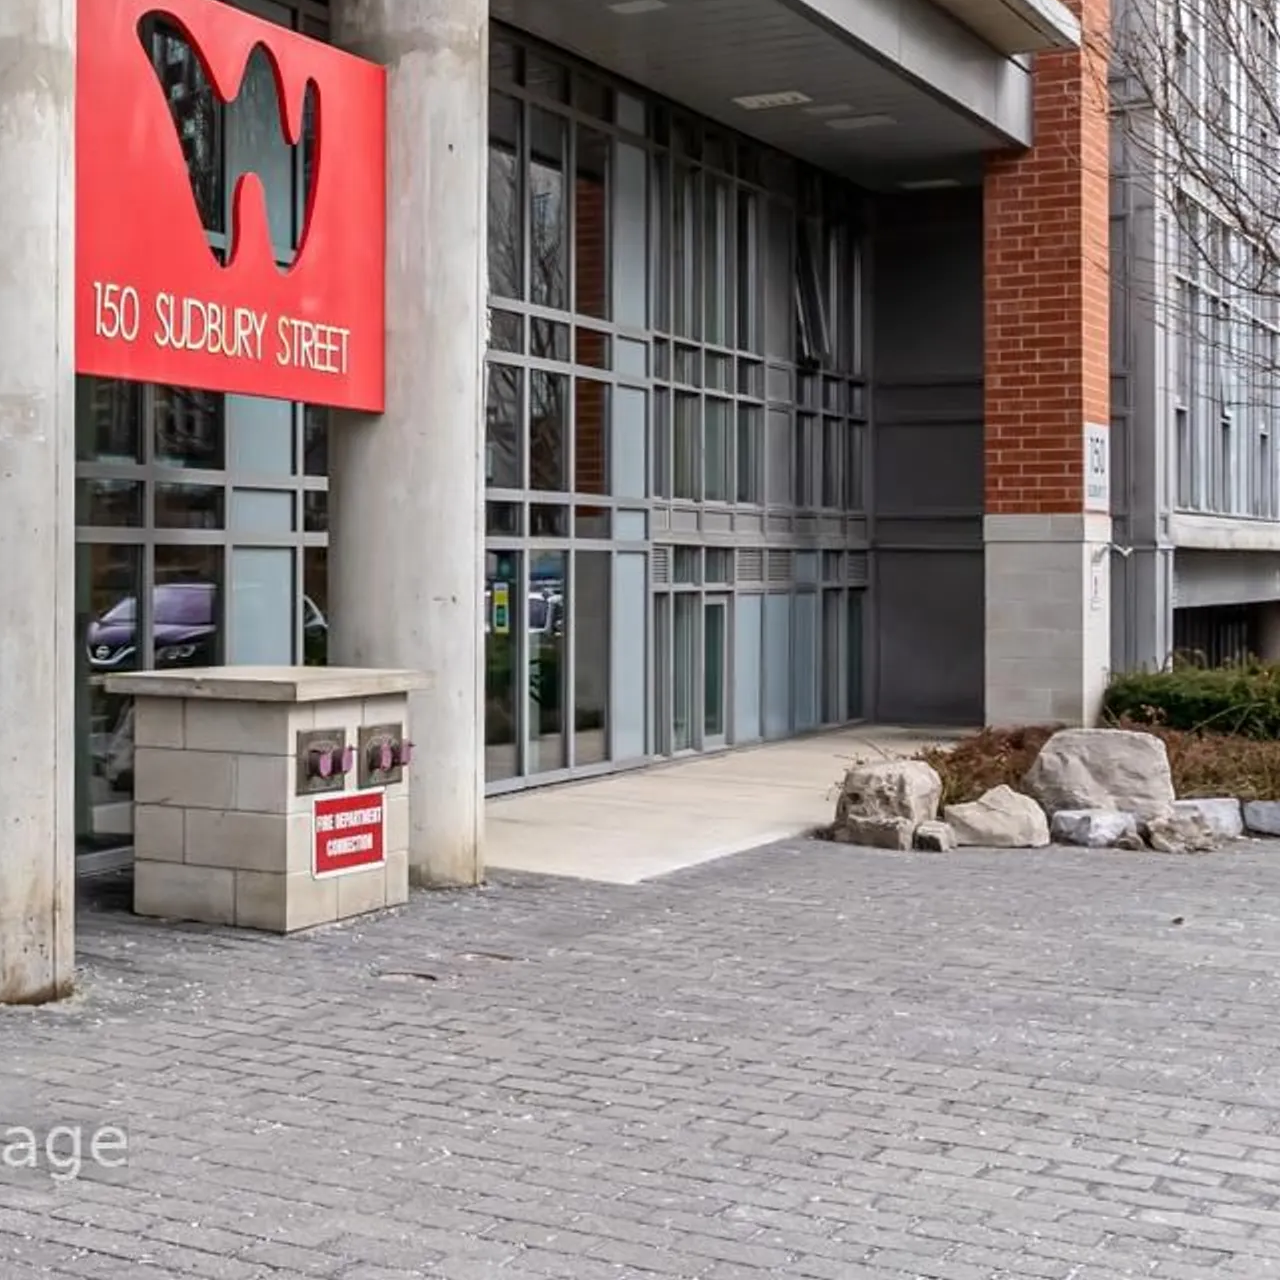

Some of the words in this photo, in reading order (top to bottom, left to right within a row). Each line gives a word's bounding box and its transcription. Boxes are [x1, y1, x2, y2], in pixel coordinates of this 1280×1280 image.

[93, 281, 140, 341] 150
[154, 291, 267, 360] SUDBURY
[276, 315, 350, 374] STREET
[316, 813, 334, 833] FIRE
[336, 805, 382, 830] DEPARTMENT
[326, 831, 374, 857] CONNECTION
